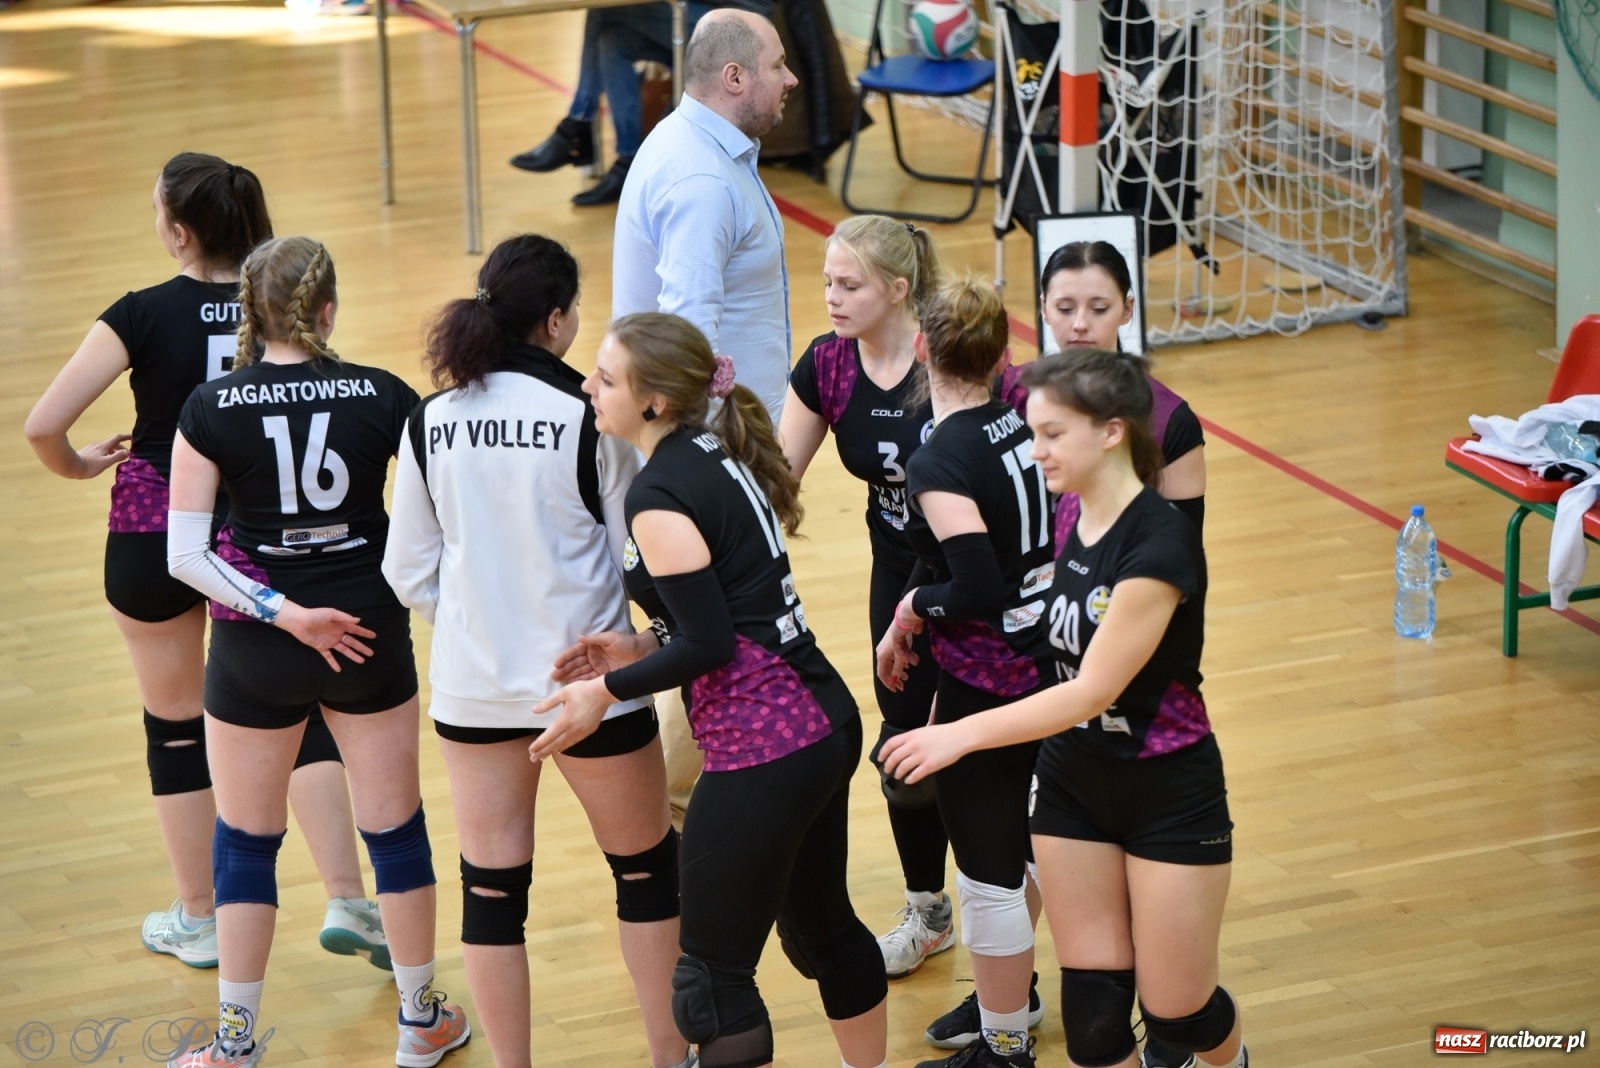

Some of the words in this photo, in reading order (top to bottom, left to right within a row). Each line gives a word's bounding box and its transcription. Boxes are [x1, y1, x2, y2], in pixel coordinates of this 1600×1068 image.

[200, 302, 246, 323] GUT
[217, 379, 377, 408] ZAGARTOWSKA
[871, 408, 904, 418] COLO
[430, 421, 457, 455] PV
[466, 419, 567, 451] VOLLEY
[262, 412, 350, 515] 16
[877, 441, 906, 483] 3
[1001, 438, 1049, 556] 17
[1049, 594, 1081, 657] 20
